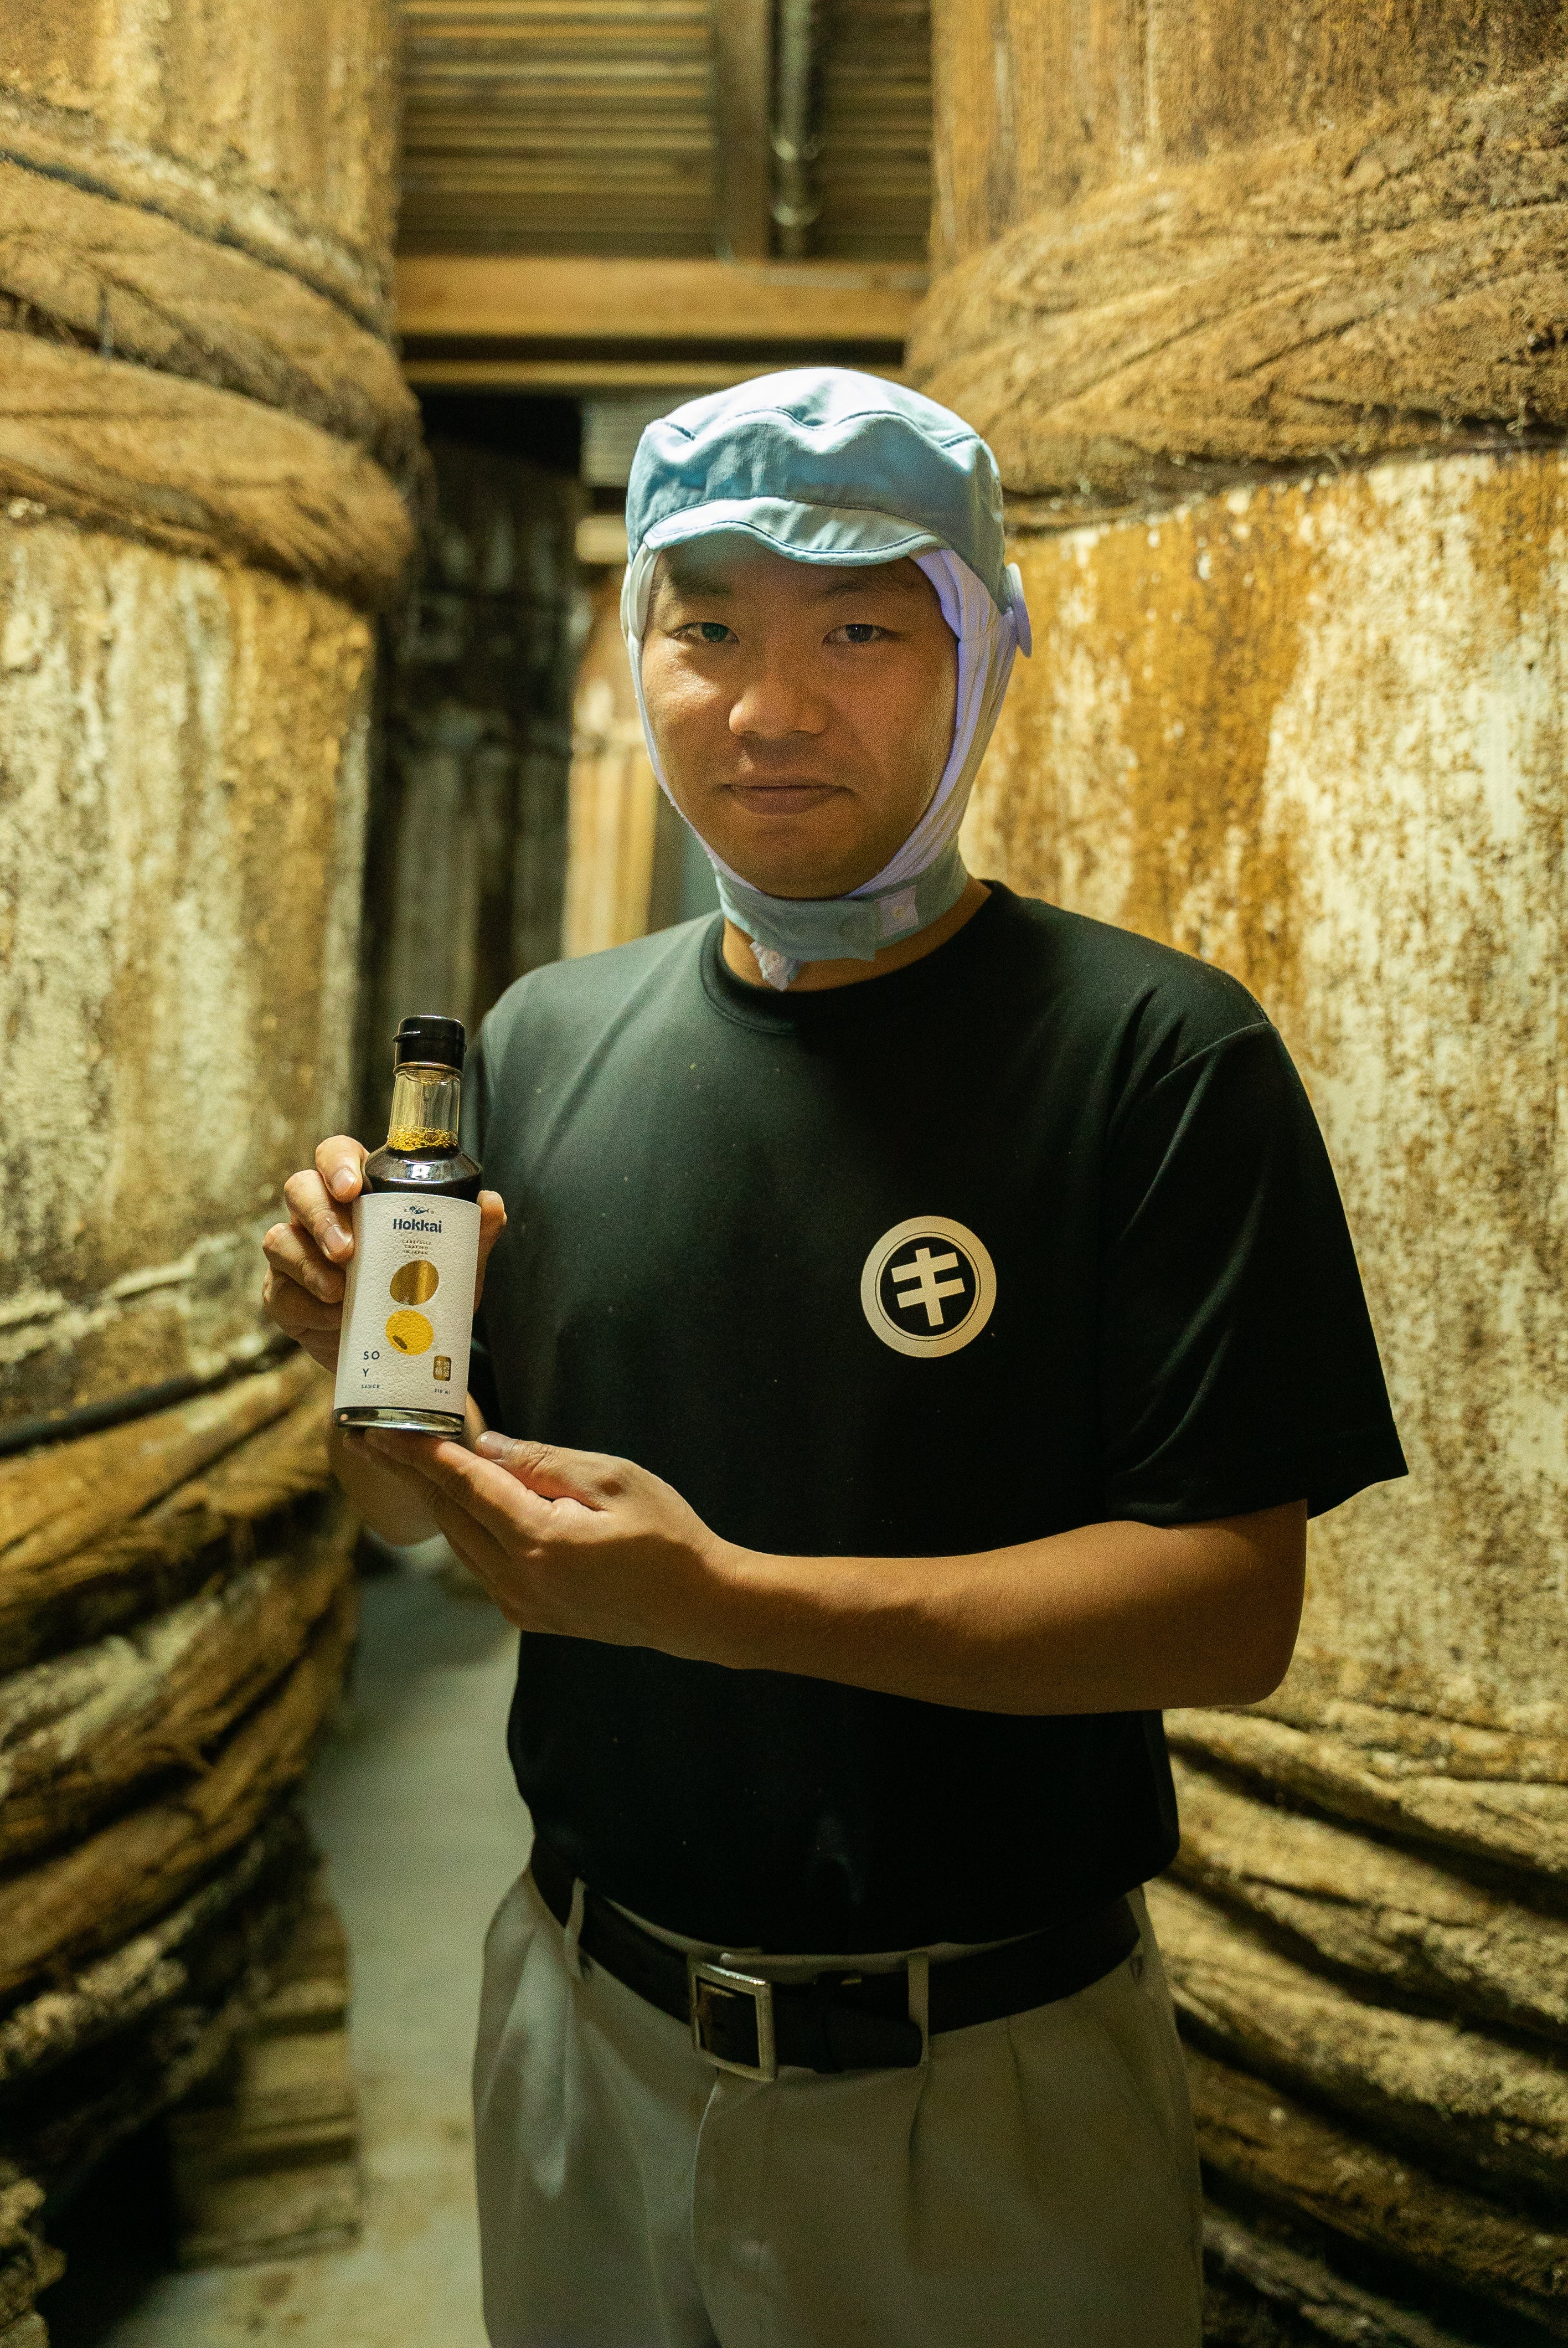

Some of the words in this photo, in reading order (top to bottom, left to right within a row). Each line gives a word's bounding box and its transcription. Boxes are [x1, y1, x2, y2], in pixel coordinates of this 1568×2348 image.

[393, 1218, 442, 1233] Hokkai
[363, 1351, 380, 1360] SO
[363, 1368, 369, 1377] Y
